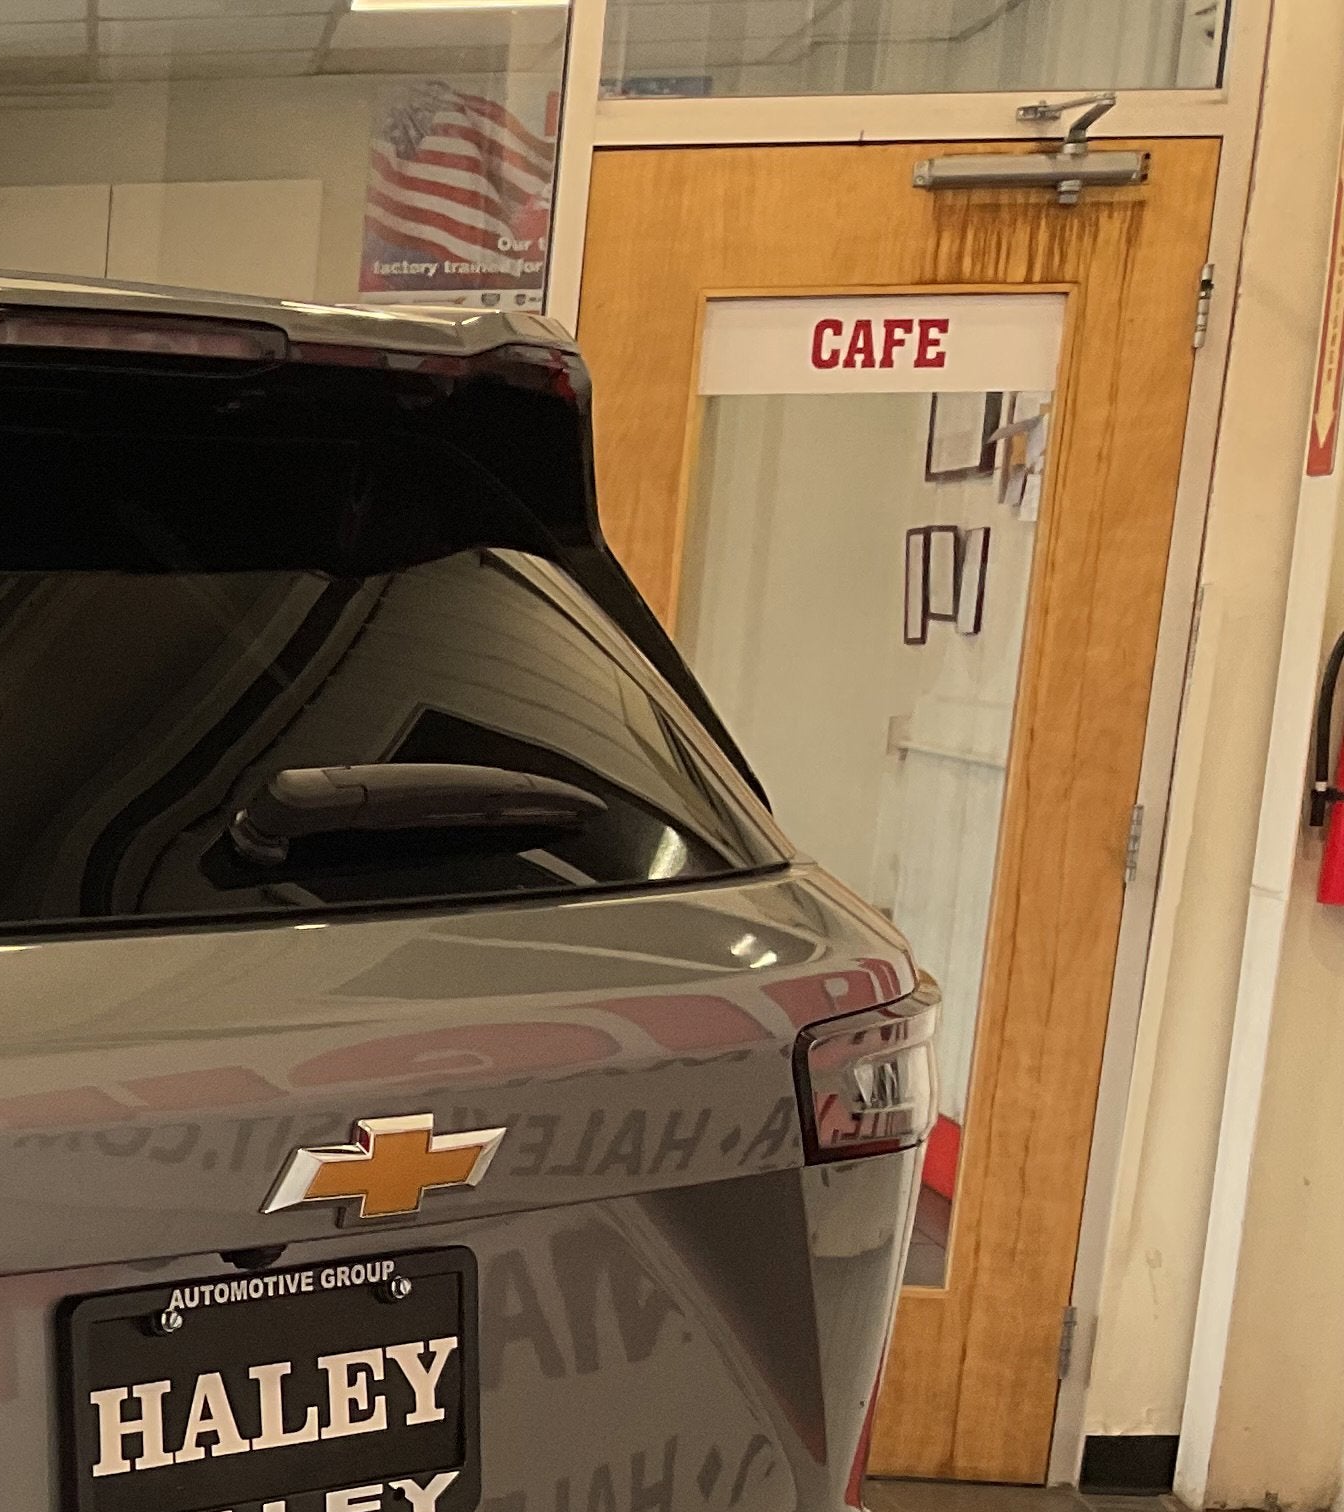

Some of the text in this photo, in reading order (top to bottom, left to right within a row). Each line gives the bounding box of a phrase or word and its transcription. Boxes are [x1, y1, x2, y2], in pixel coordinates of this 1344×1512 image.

[811, 318, 950, 370] CAFE
[169, 1260, 396, 1310] AUTOMOTIVE GROUP
[90, 1336, 459, 1478] HALEY
